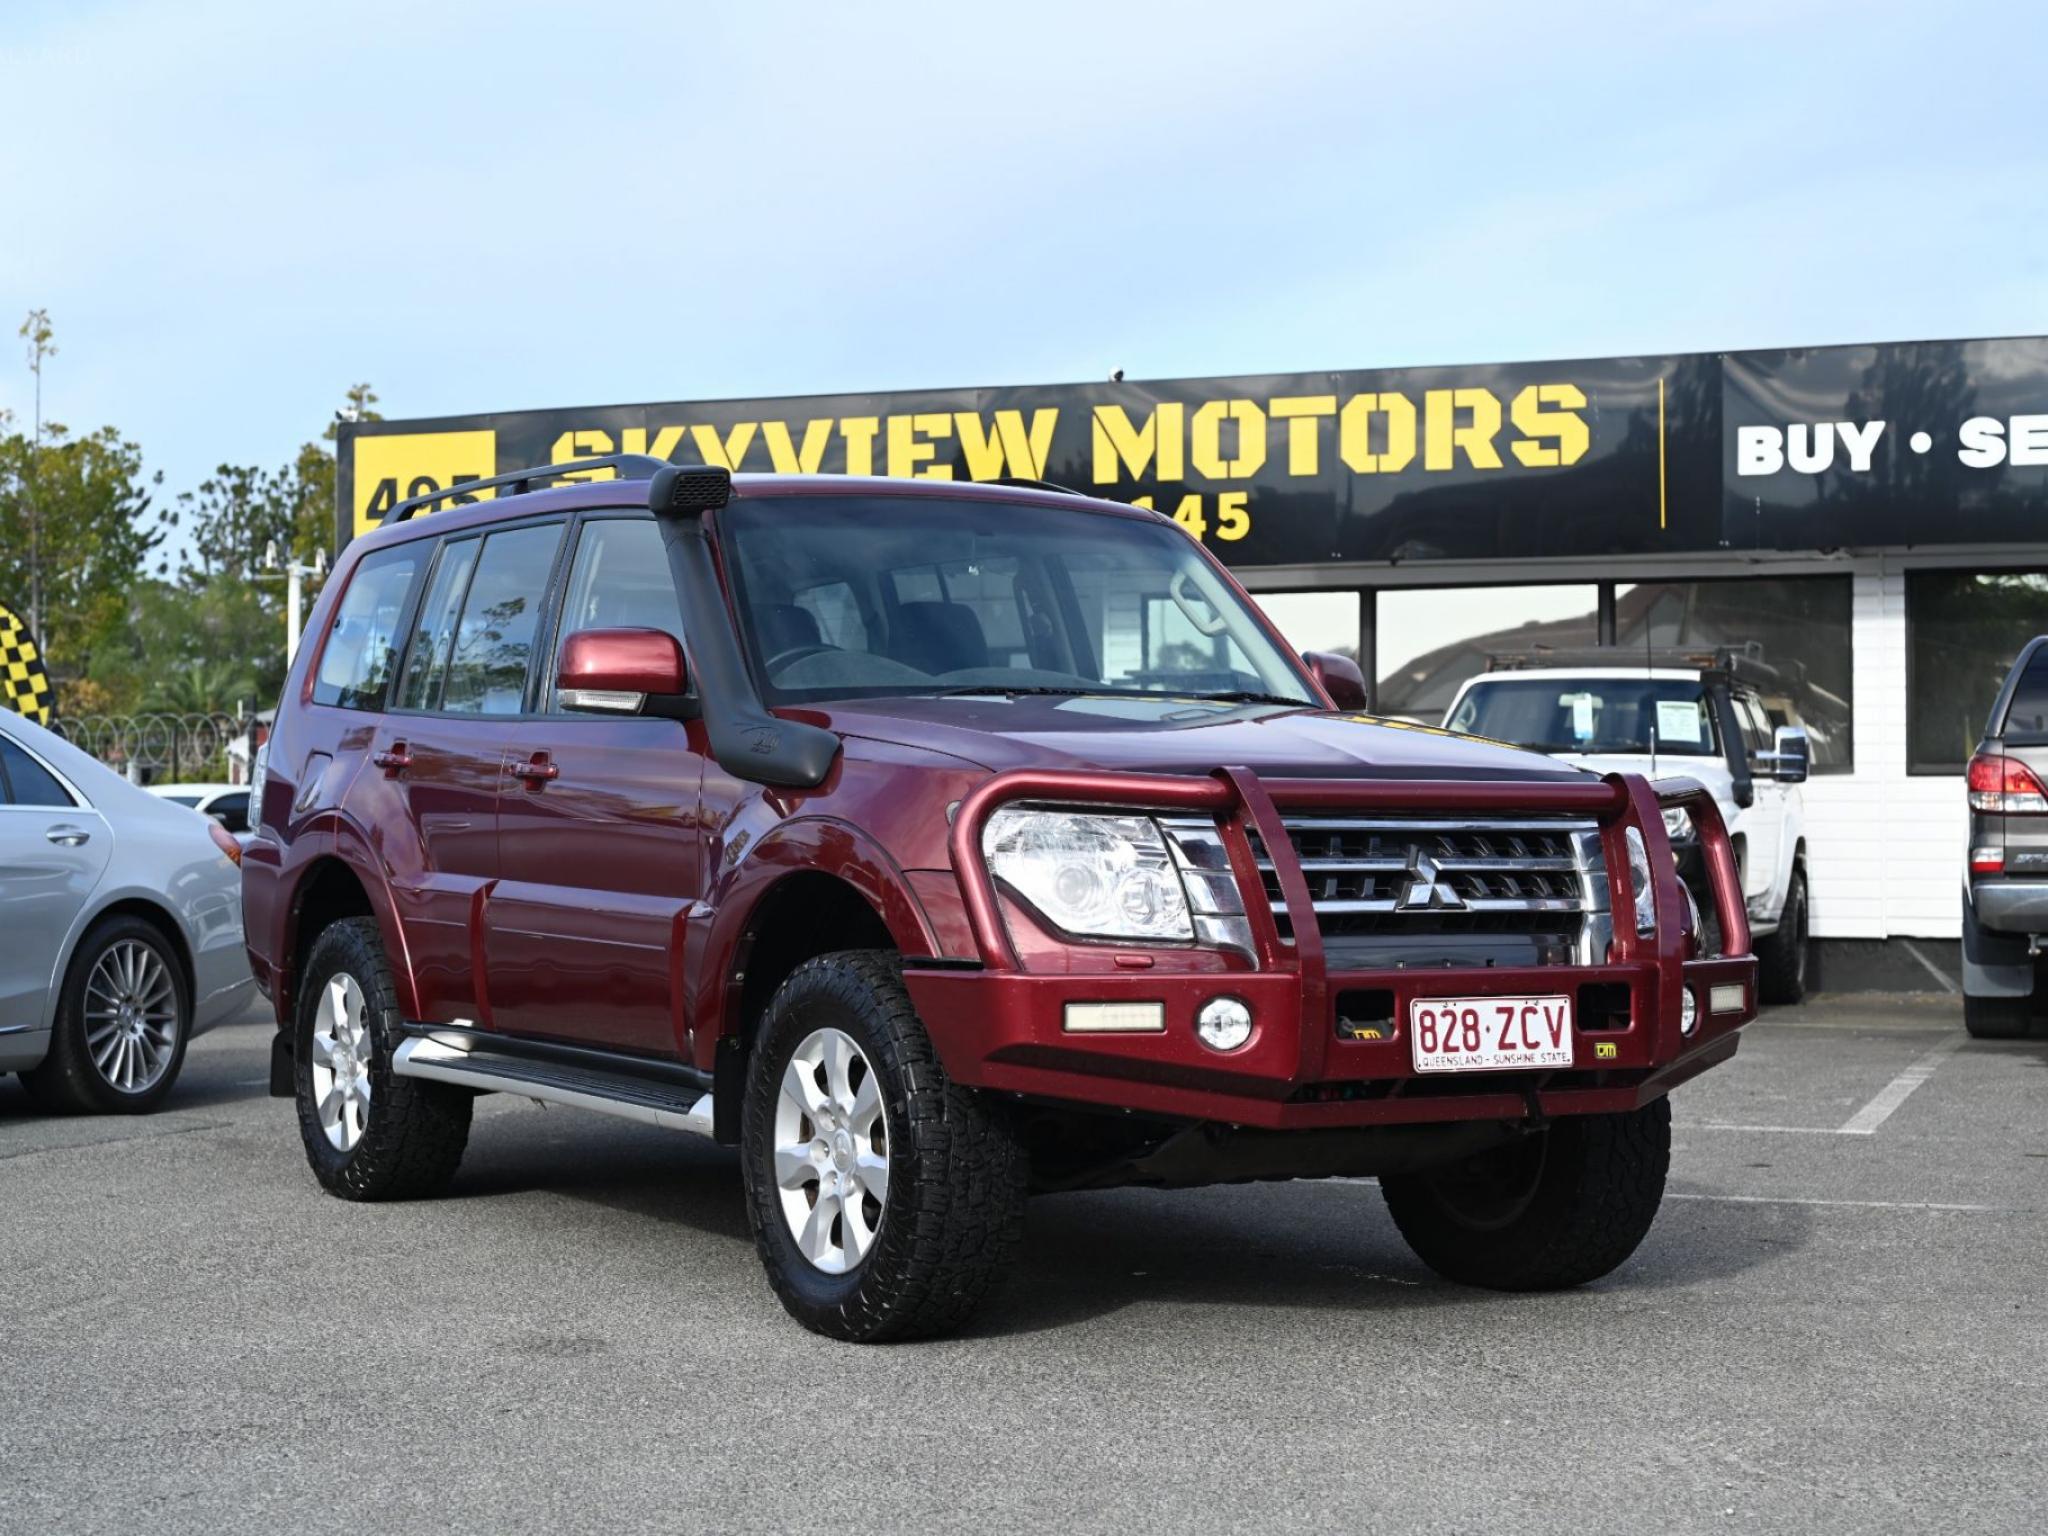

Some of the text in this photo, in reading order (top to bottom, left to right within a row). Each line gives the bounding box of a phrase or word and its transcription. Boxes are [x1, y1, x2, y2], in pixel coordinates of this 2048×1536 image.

[1094, 387, 1589, 485] MOTORS
[1737, 421, 1886, 477] BUY
[1423, 1055, 1483, 1067] QUEENSLAND
[1494, 1053, 1536, 1065] SUNSHINE
[1542, 1052, 1567, 1063] STATE
